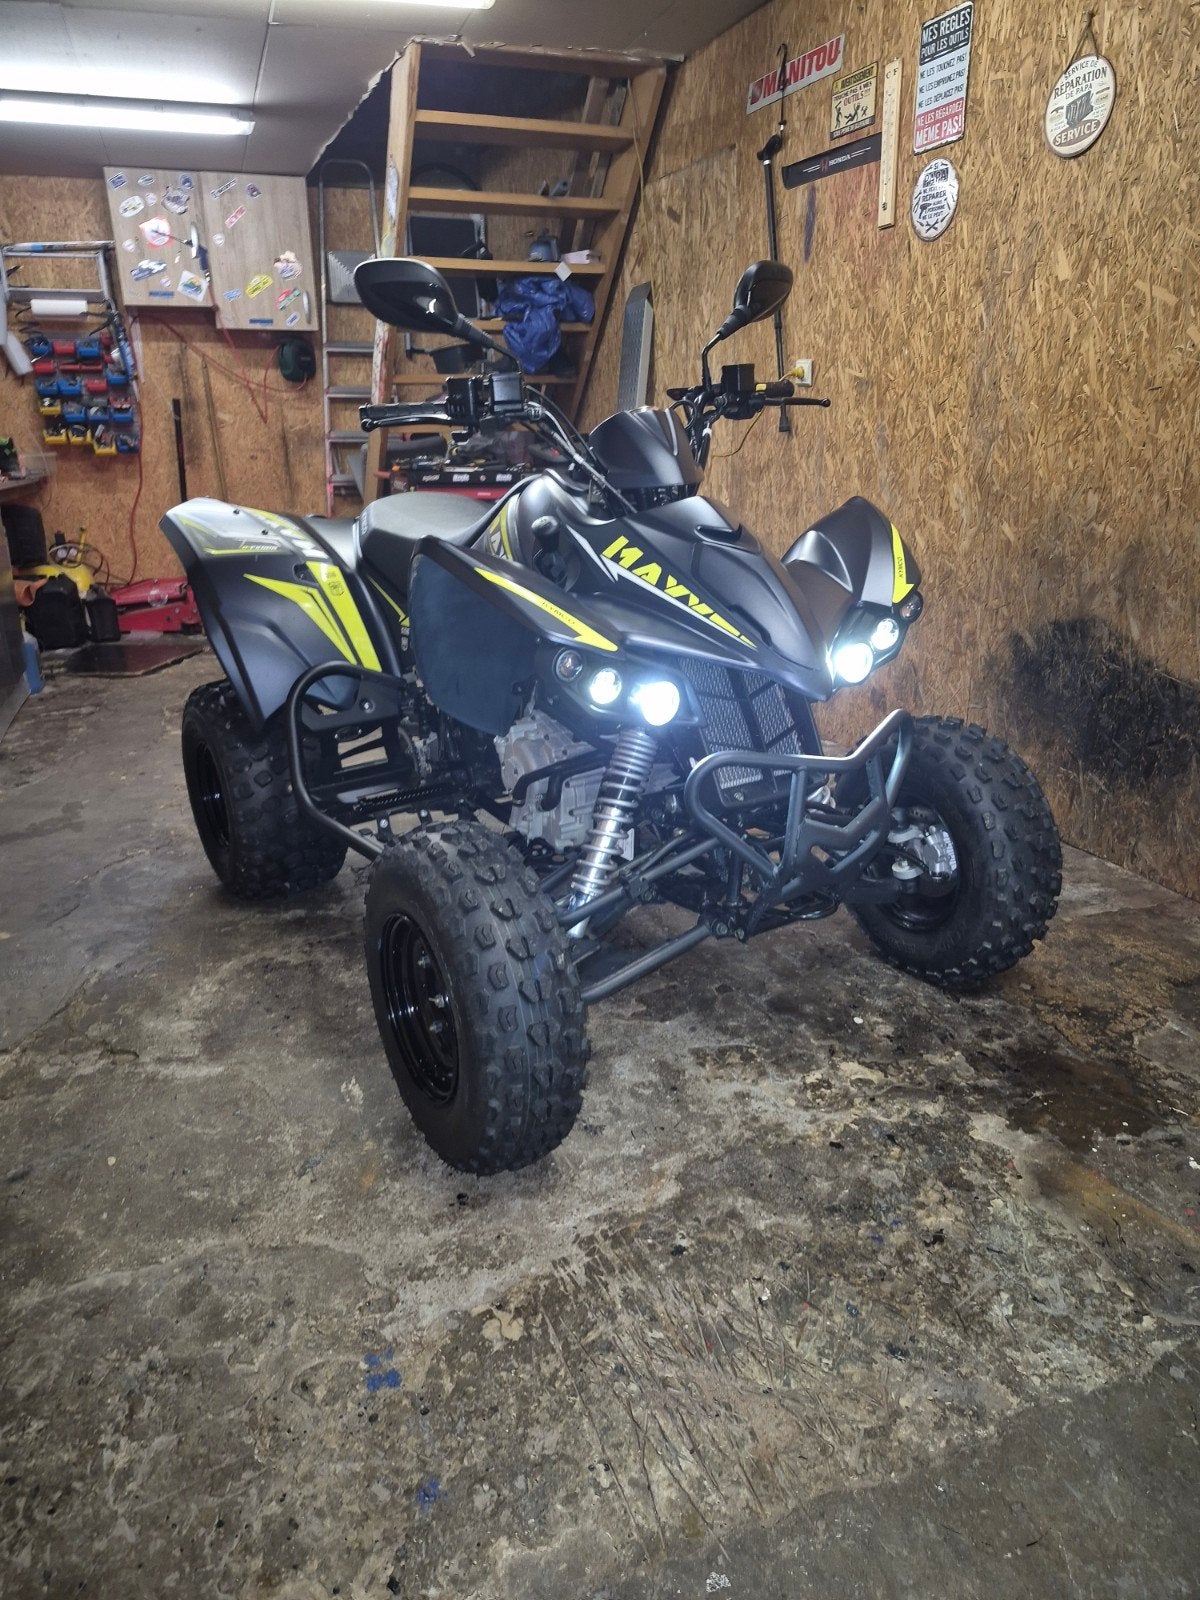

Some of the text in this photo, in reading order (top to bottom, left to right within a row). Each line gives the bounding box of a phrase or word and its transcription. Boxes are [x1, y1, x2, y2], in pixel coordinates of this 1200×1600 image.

[920, 27, 970, 59] POUR LES OUTILS
[921, 23, 938, 46] MES
[885, 67, 898, 79] C F
[926, 66, 935, 78] LES
[1064, 59, 1099, 80] SERVICE DE
[926, 82, 934, 92] LES
[1053, 66, 1108, 100] RÉPARATION
[1065, 82, 1093, 100] DE PAPA
[925, 97, 933, 107] LES
[925, 111, 935, 125] LES
[941, 114, 962, 139] PAS!
[1054, 120, 1098, 147] SERVICE
[828, 153, 851, 167] HONDA
